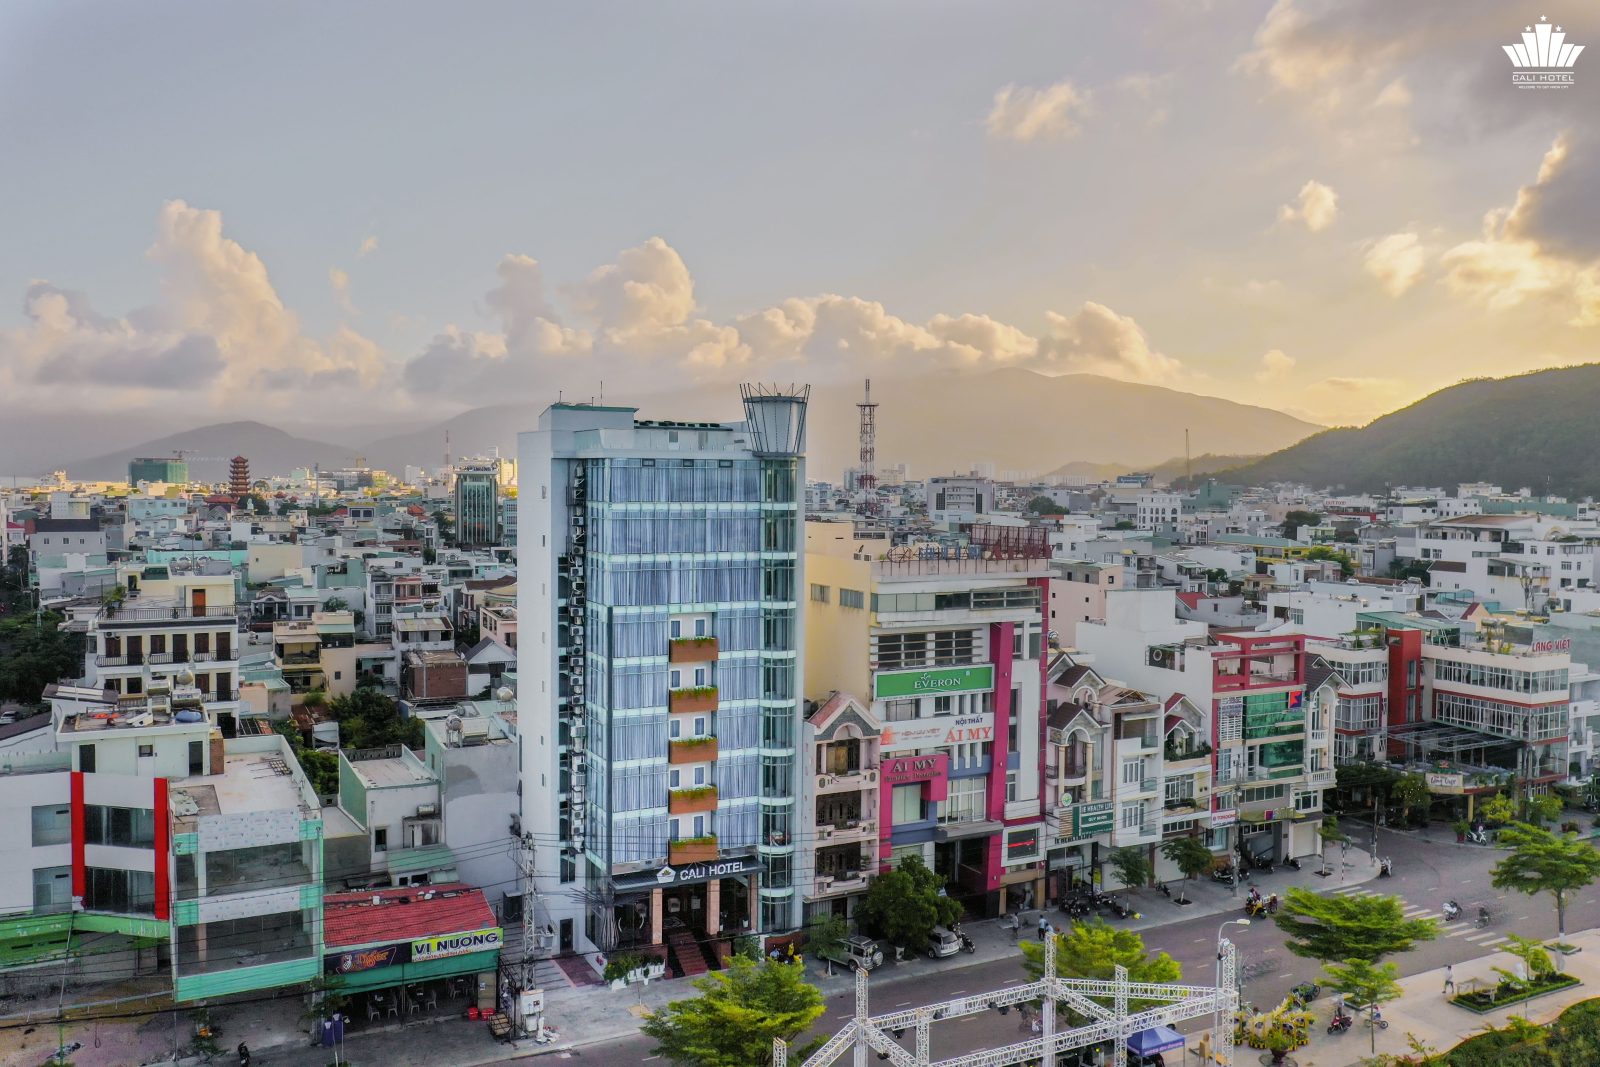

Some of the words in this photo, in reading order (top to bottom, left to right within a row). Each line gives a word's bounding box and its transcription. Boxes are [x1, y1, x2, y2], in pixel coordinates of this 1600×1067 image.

[914, 677, 961, 689] EVERON
[679, 866, 706, 881] CALI
[708, 861, 747, 877] HOTEL
